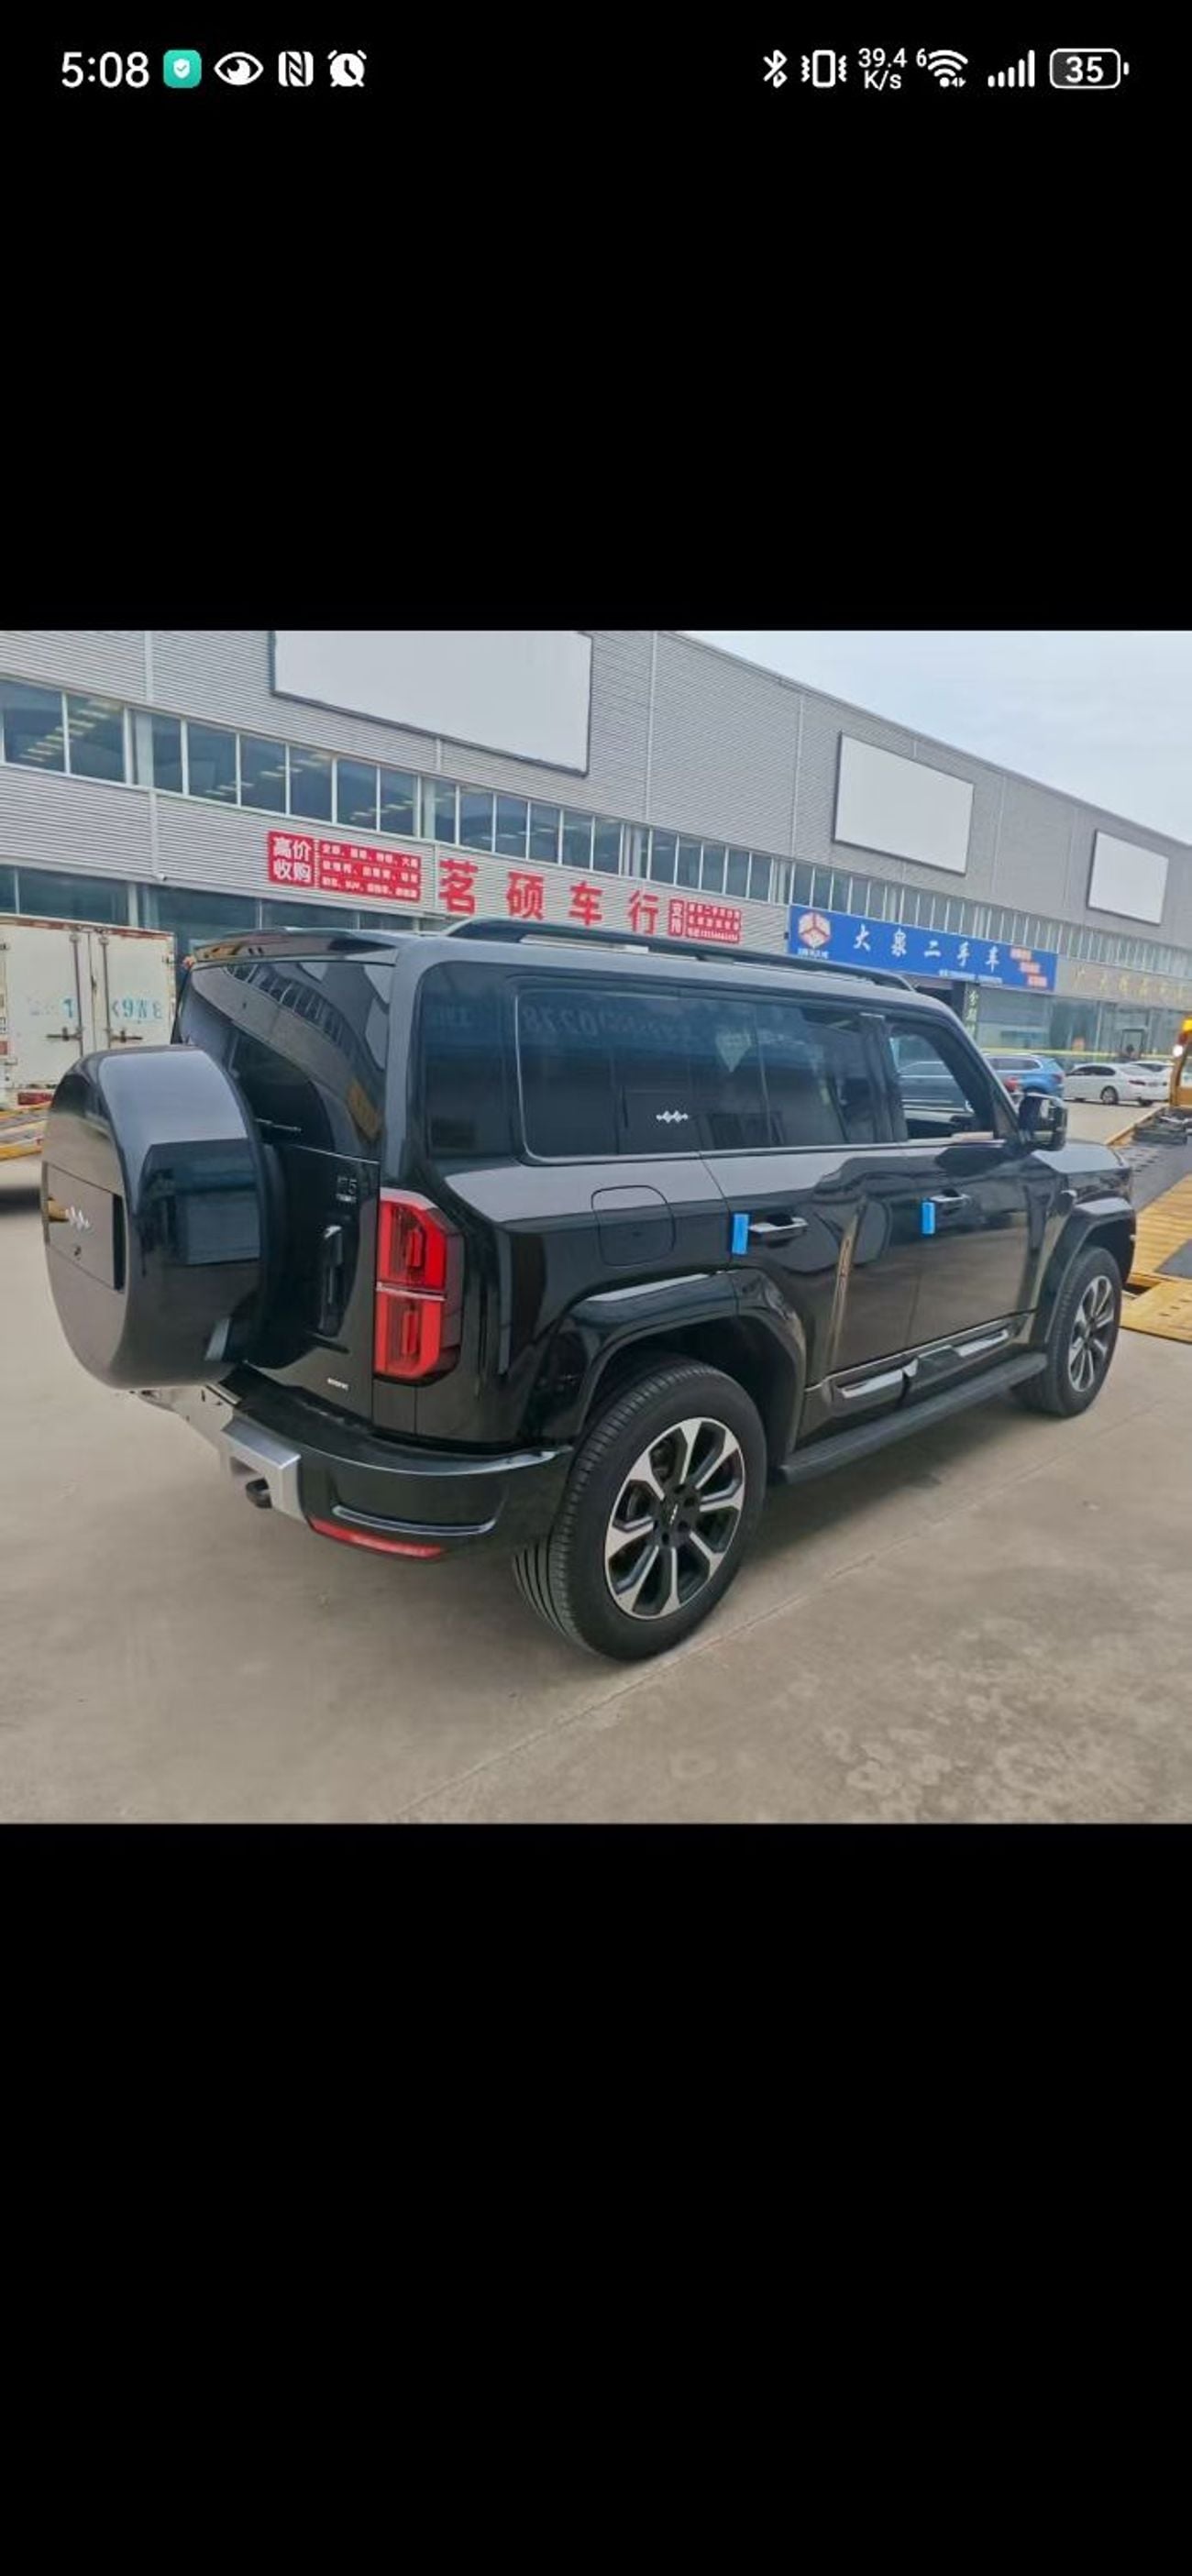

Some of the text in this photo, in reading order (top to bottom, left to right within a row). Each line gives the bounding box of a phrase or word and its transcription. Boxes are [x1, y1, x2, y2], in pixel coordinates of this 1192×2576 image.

[272, 836, 313, 862] 高价
[272, 860, 313, 883] 收购
[438, 858, 659, 936] 茗硕车行
